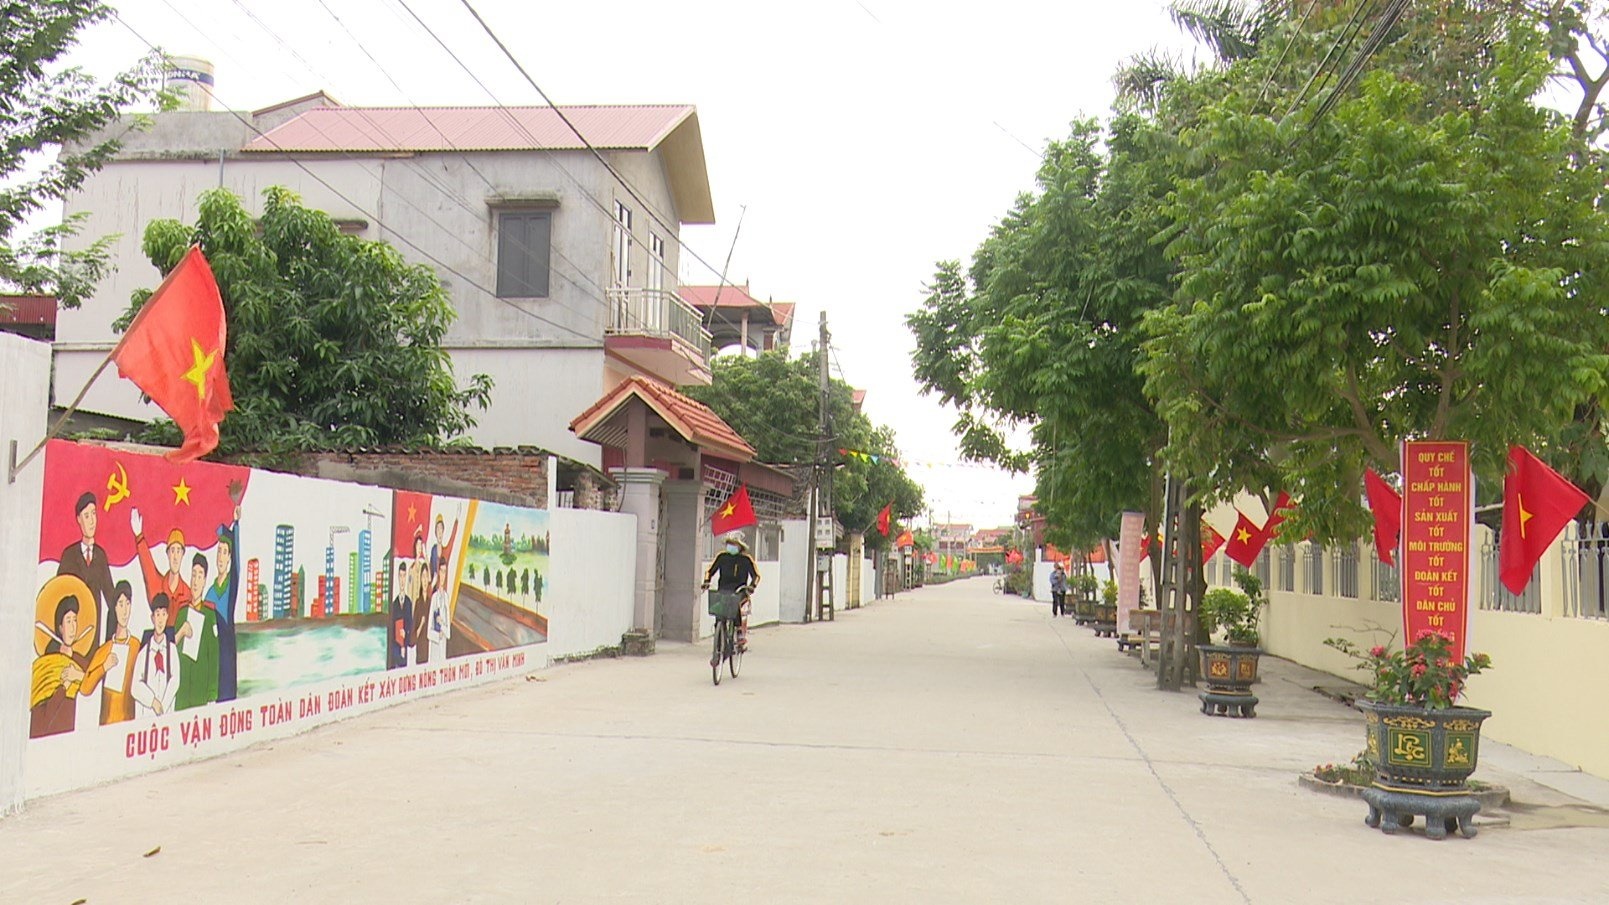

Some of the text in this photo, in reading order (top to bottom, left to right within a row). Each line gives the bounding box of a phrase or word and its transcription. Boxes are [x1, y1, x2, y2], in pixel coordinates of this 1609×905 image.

[1418, 449, 1455, 463] QUY CHẾ
[1429, 464, 1444, 477] TỐT
[1411, 479, 1461, 492] CHẤP HÀNH
[1429, 494, 1444, 507] TỐT
[1414, 508, 1458, 522] SẢN XUẤT
[1429, 523, 1444, 537] TỐT
[1409, 539, 1463, 552] MÔI TRƯỜNG
[1428, 553, 1444, 567] TỐT
[1414, 568, 1458, 581] ĐOÀN KẾT
[1428, 583, 1444, 596] TỐT
[1416, 597, 1456, 612] DÂN CHỦ
[1428, 613, 1444, 626] TỐT
[126, 722, 170, 760] CUỘC
[180, 714, 212, 748] VẬN
[219, 707, 253, 739] ĐỘNG
[260, 697, 292, 727] TOÀN
[299, 692, 321, 718] DÂN
[328, 684, 353, 712] ĐOÀN
[358, 676, 375, 704] KẾT
[379, 676, 396, 699] XÂY
[419, 668, 437, 689] NÔNG
